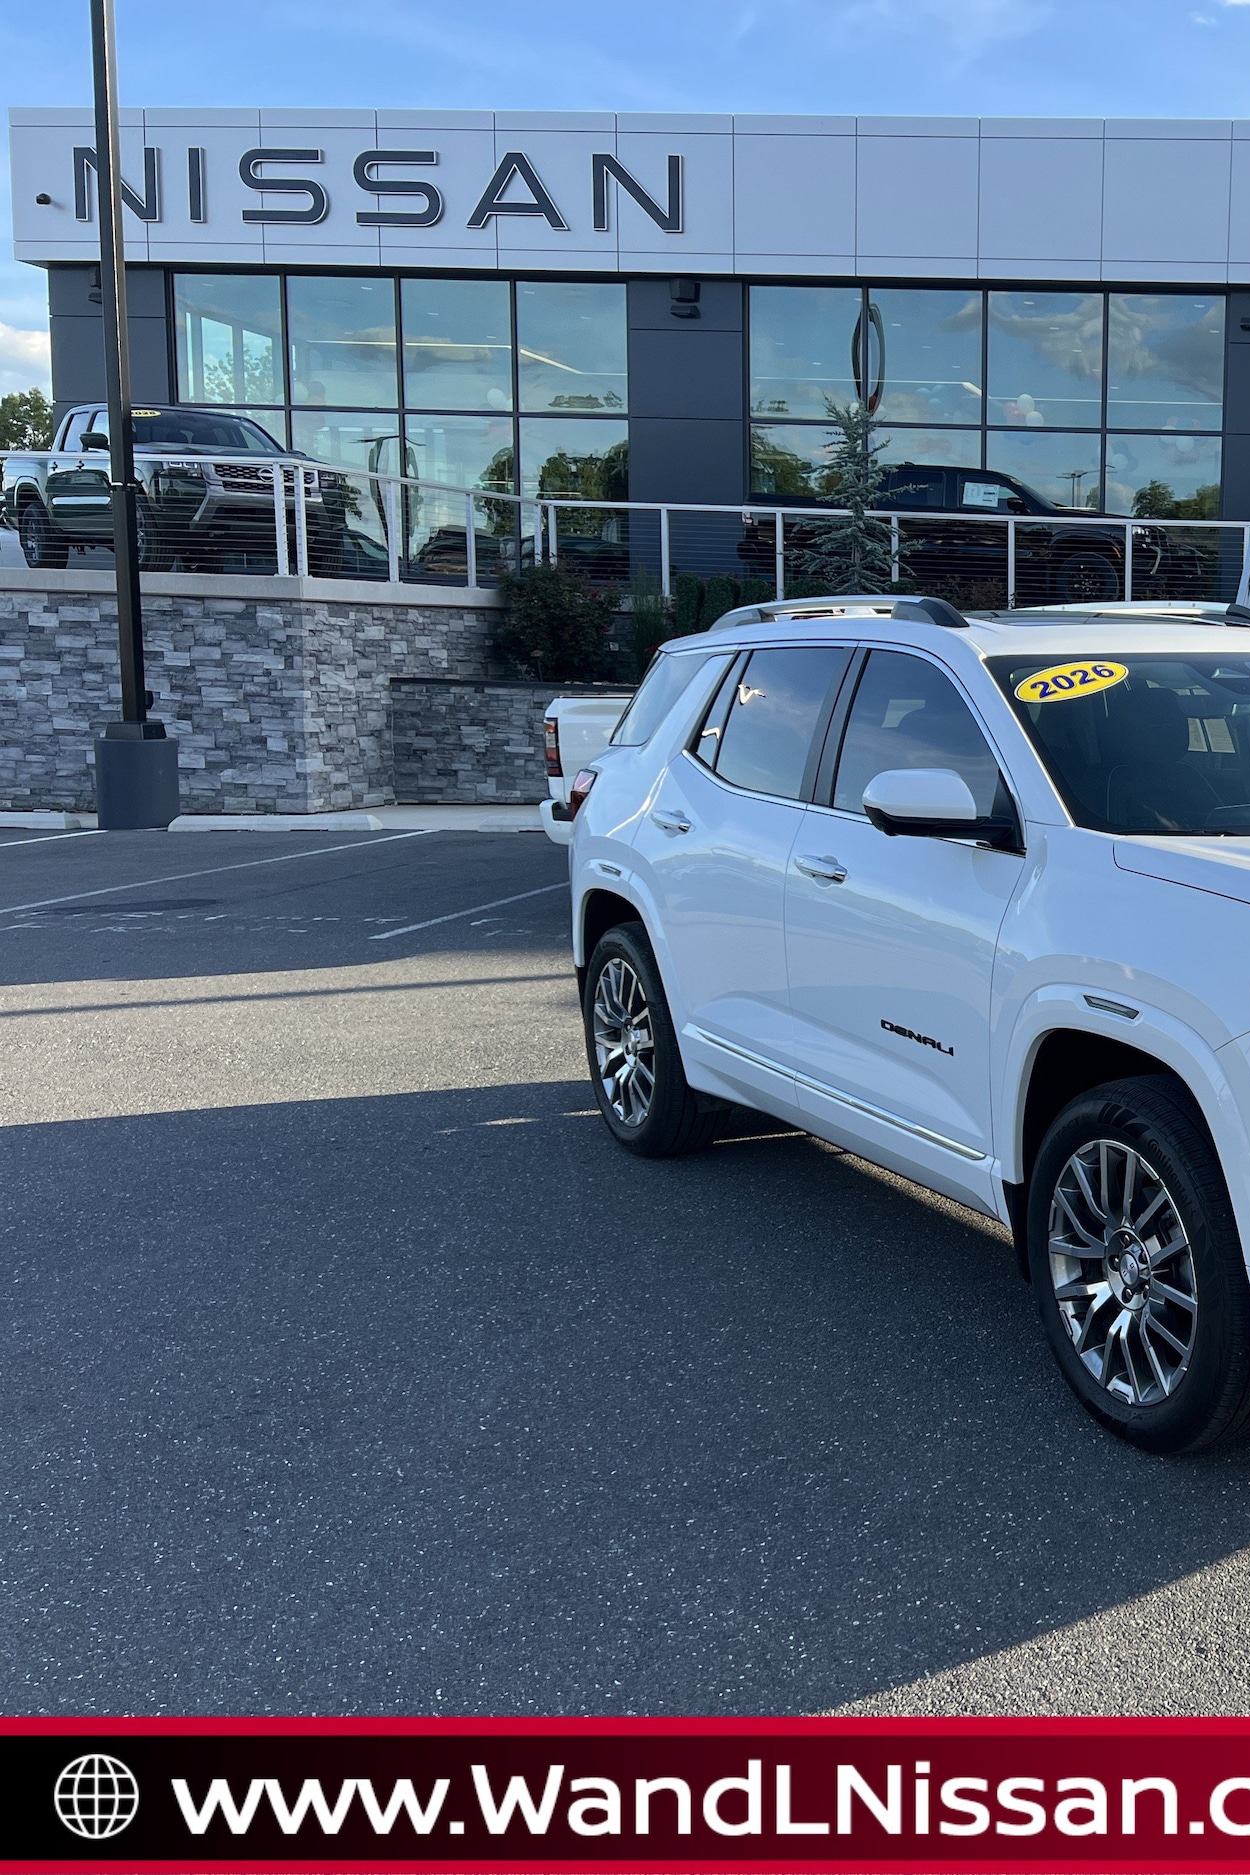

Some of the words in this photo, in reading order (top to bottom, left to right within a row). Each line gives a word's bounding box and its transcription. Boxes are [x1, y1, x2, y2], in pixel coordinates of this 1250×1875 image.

[73, 146, 684, 233] NISSAN
[1030, 665, 1115, 699] 2026
[880, 1019, 954, 1056] DENALI
